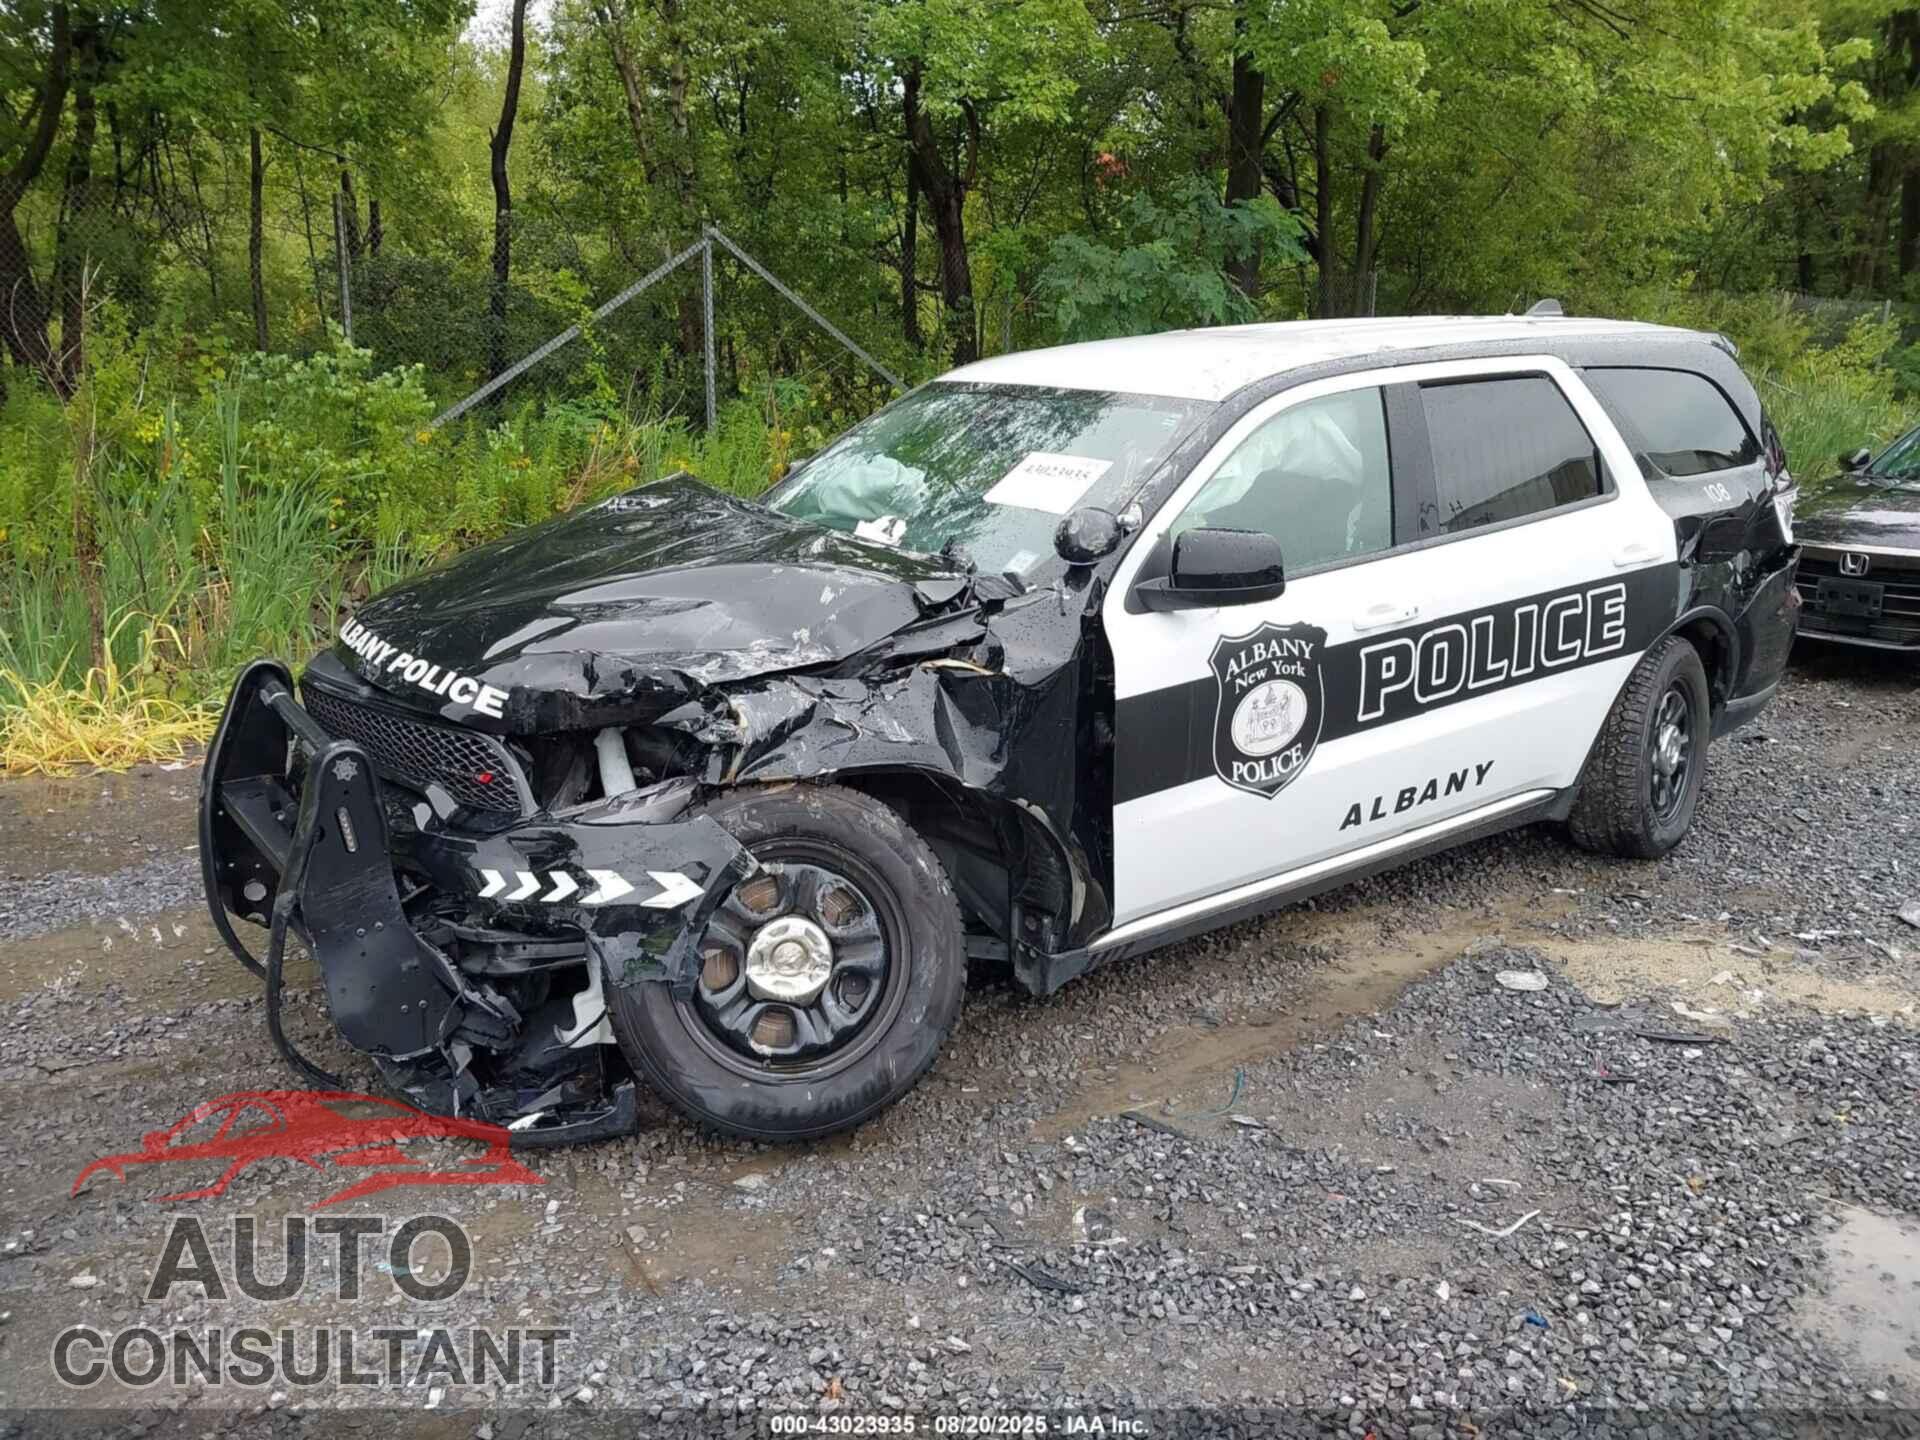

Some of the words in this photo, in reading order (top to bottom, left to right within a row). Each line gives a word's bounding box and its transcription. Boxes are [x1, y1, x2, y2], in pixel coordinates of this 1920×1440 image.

[1703, 483, 1730, 503] 108
[1225, 638, 1314, 682] ALBANY
[1357, 583, 1626, 722] POLICE
[386, 652, 509, 719] POLICE
[1234, 668, 1267, 694] New
[1271, 660, 1306, 677] York
[1232, 743, 1304, 782] POLICE
[1339, 760, 1495, 831] ALBANY
